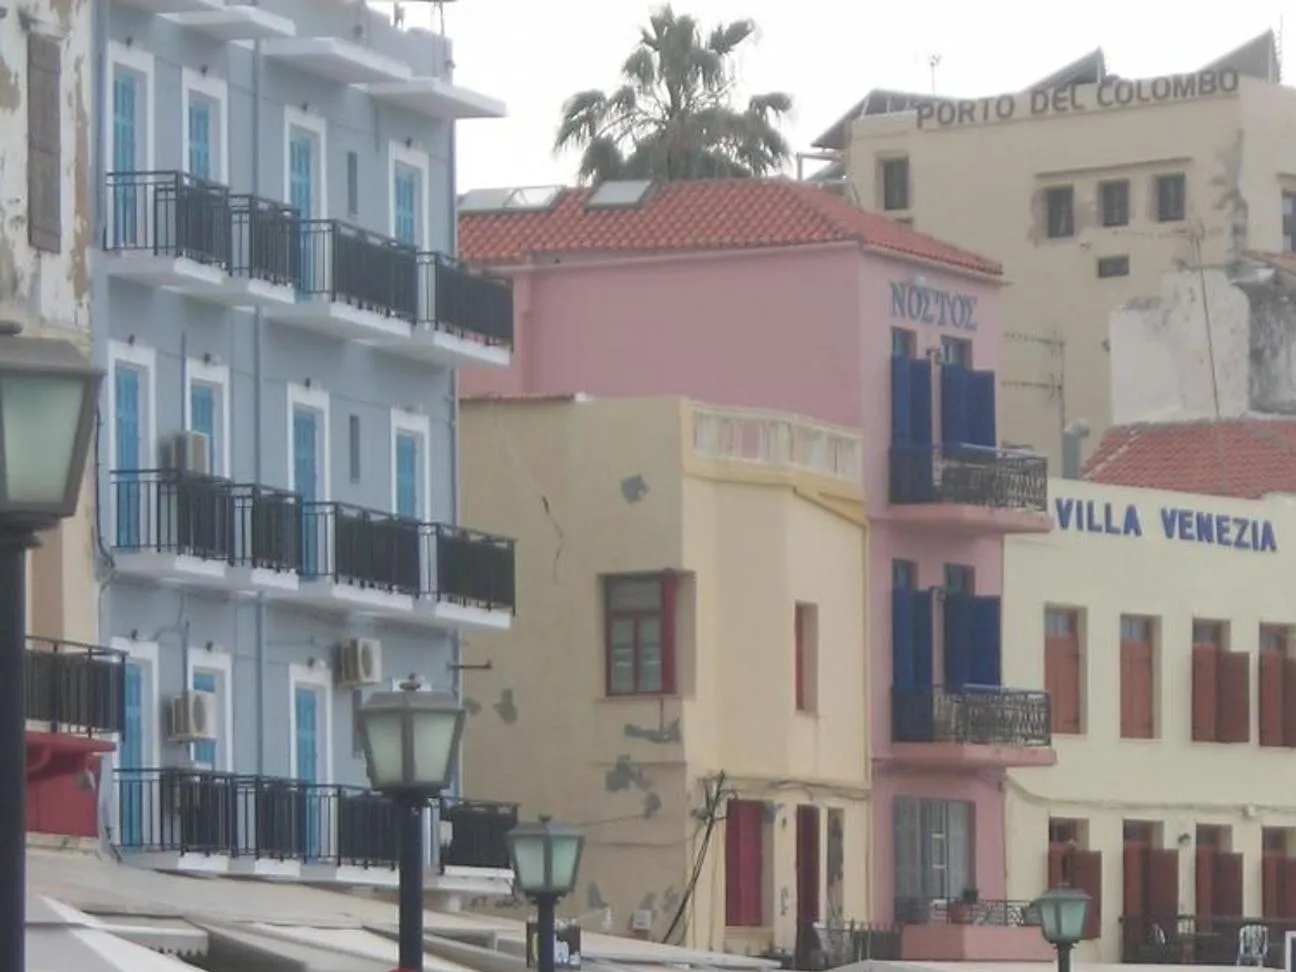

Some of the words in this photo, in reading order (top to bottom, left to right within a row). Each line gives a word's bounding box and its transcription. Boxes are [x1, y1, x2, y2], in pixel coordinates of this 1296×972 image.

[916, 95, 1015, 129] PORTO
[1030, 83, 1085, 115] DEL
[1097, 68, 1239, 107] COLOMBO
[1055, 498, 1142, 537] VILLA
[1160, 507, 1277, 552] VENEZIA
